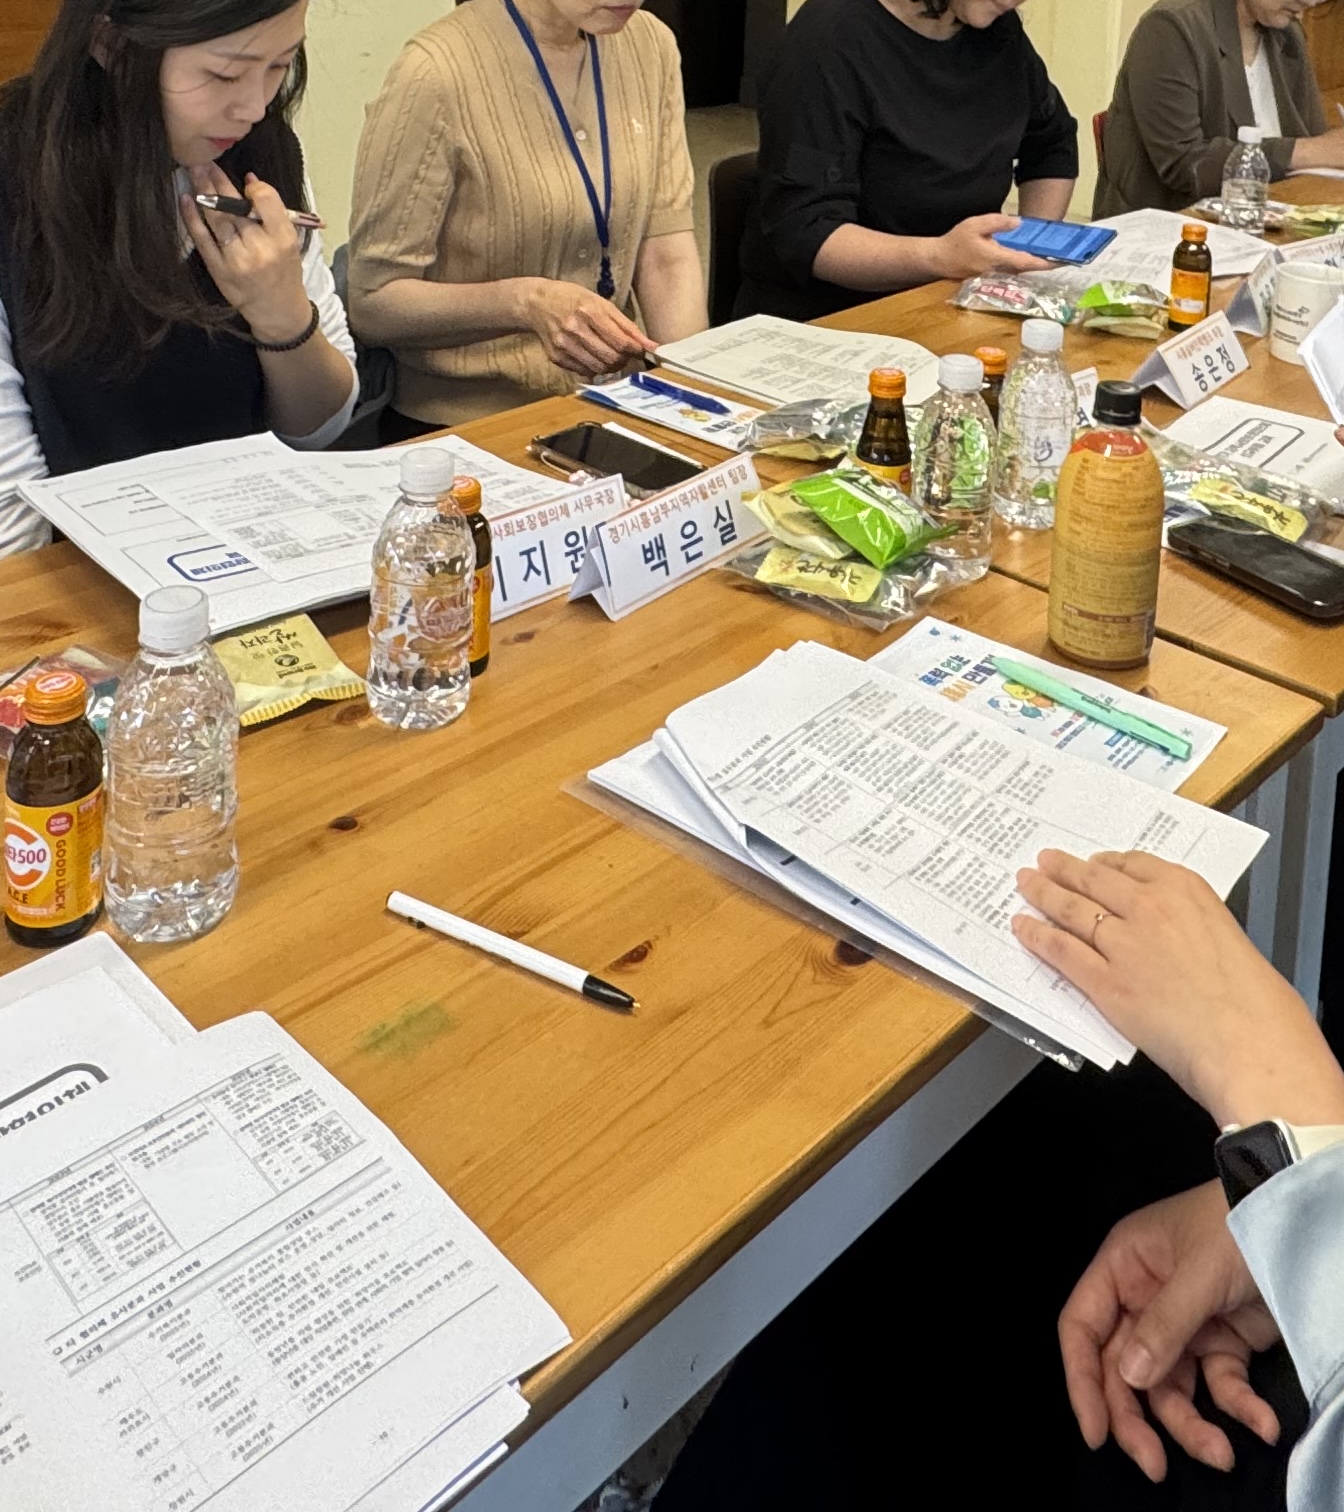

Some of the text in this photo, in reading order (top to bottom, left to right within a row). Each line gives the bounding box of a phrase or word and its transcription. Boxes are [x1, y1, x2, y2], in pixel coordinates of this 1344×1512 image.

[493, 488, 615, 541] 사회보장협의체 사무국장
[56, 840, 66, 876] GOOD
